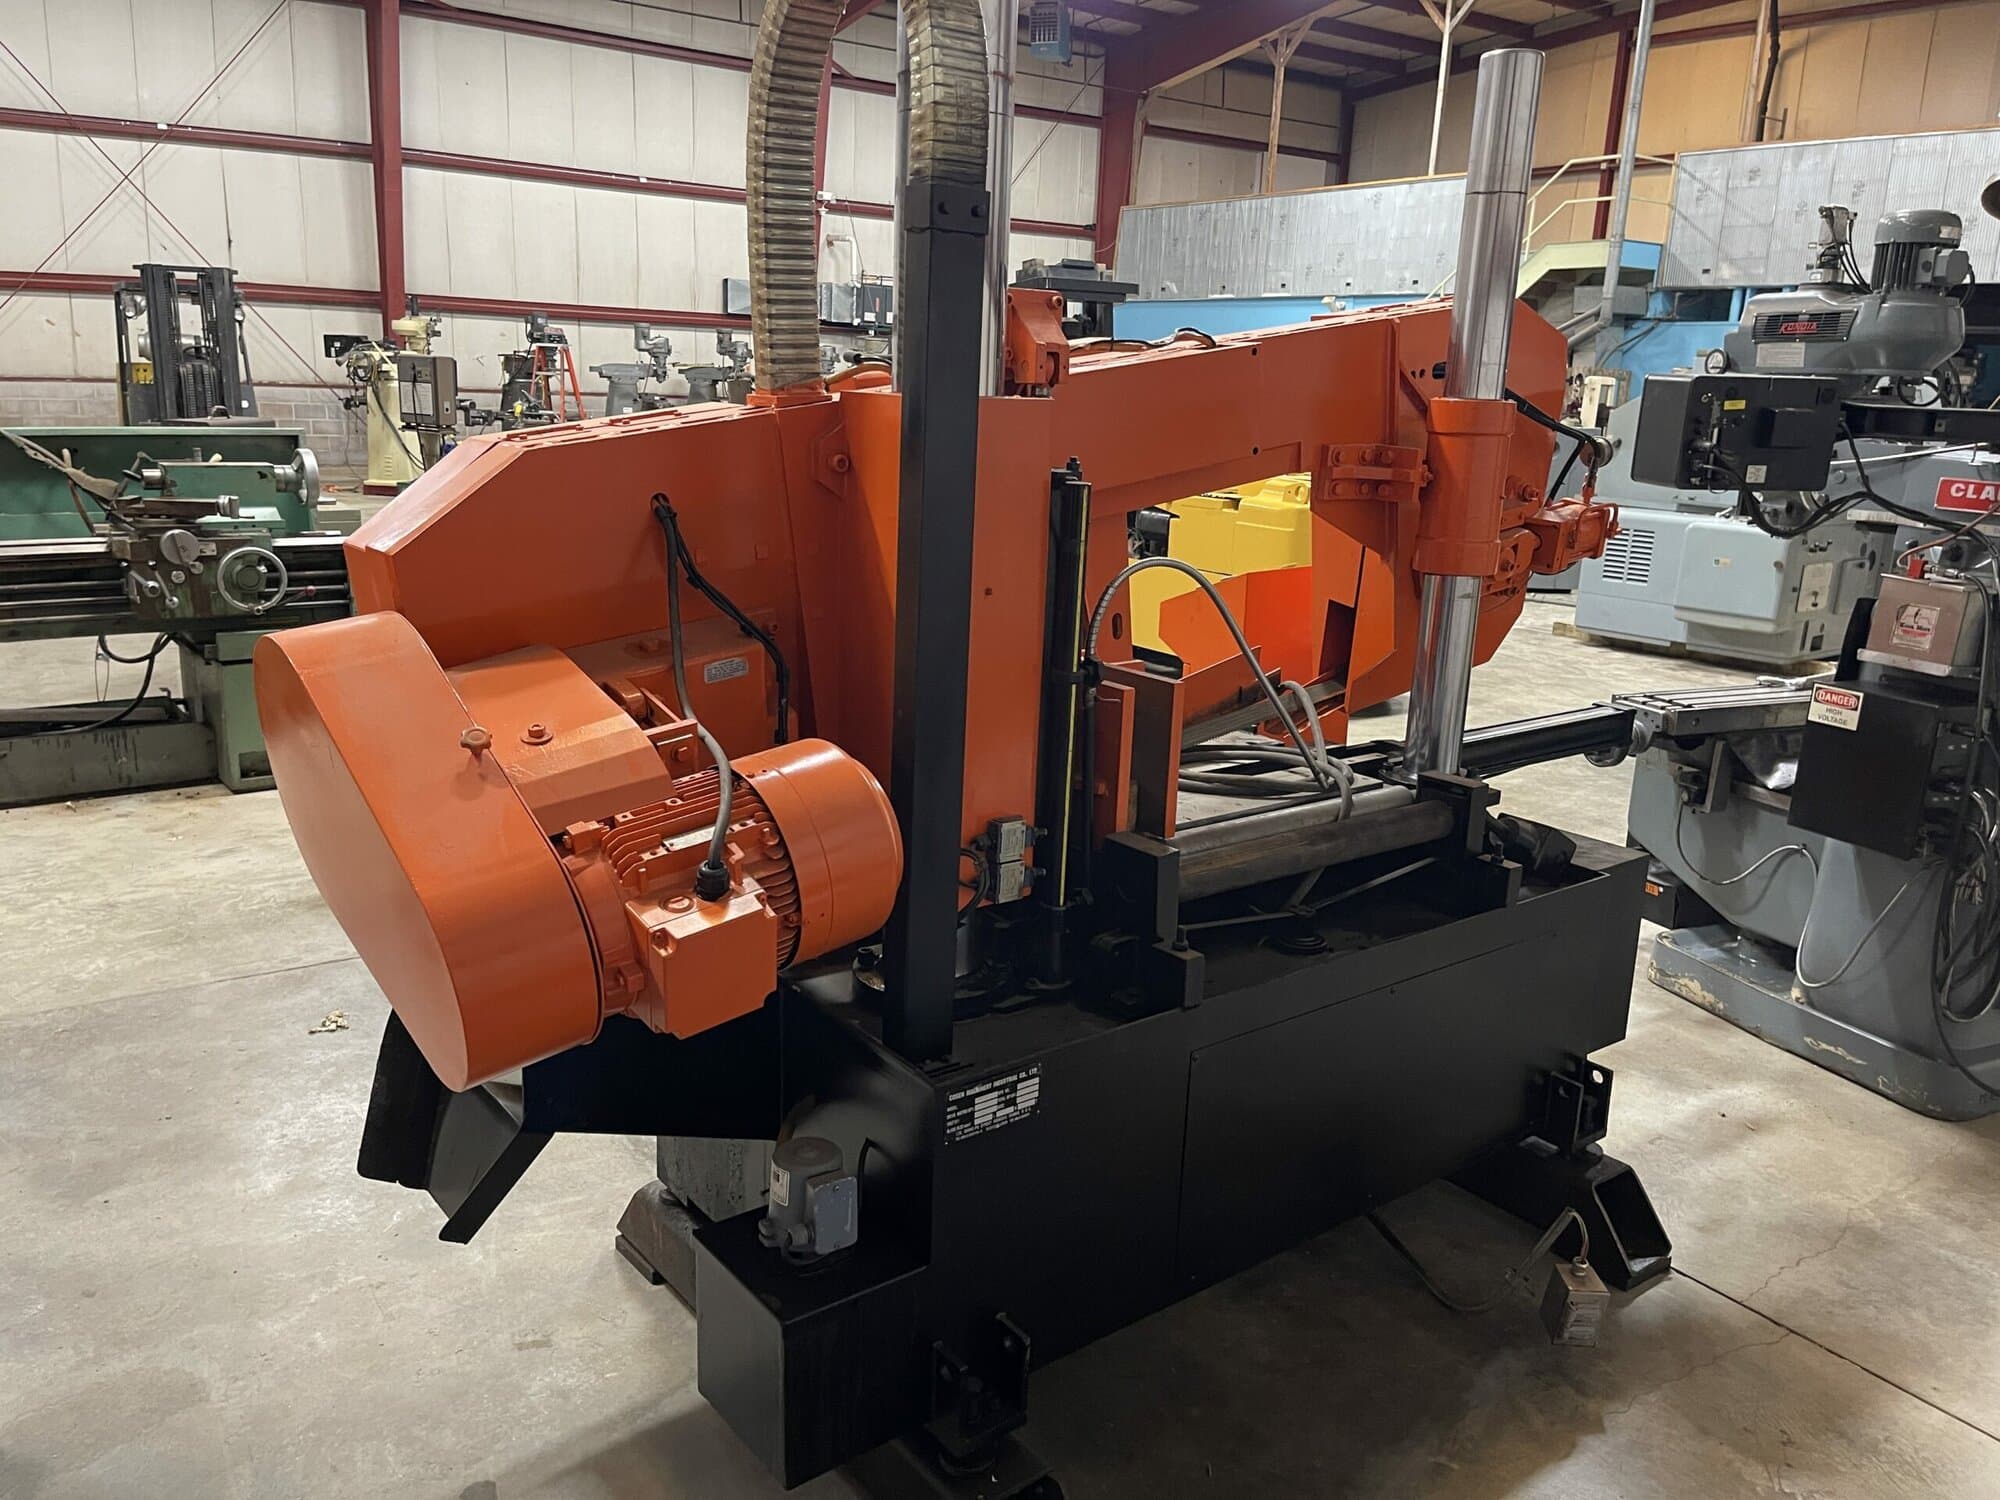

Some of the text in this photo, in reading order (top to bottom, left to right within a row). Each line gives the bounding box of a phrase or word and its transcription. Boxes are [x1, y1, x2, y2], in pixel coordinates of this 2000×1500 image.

[1950, 483, 2000, 502] CLA
[1818, 690, 1856, 708] DANGER
[1825, 707, 1843, 717] HIGH
[1818, 714, 1848, 726] VOLTAGE
